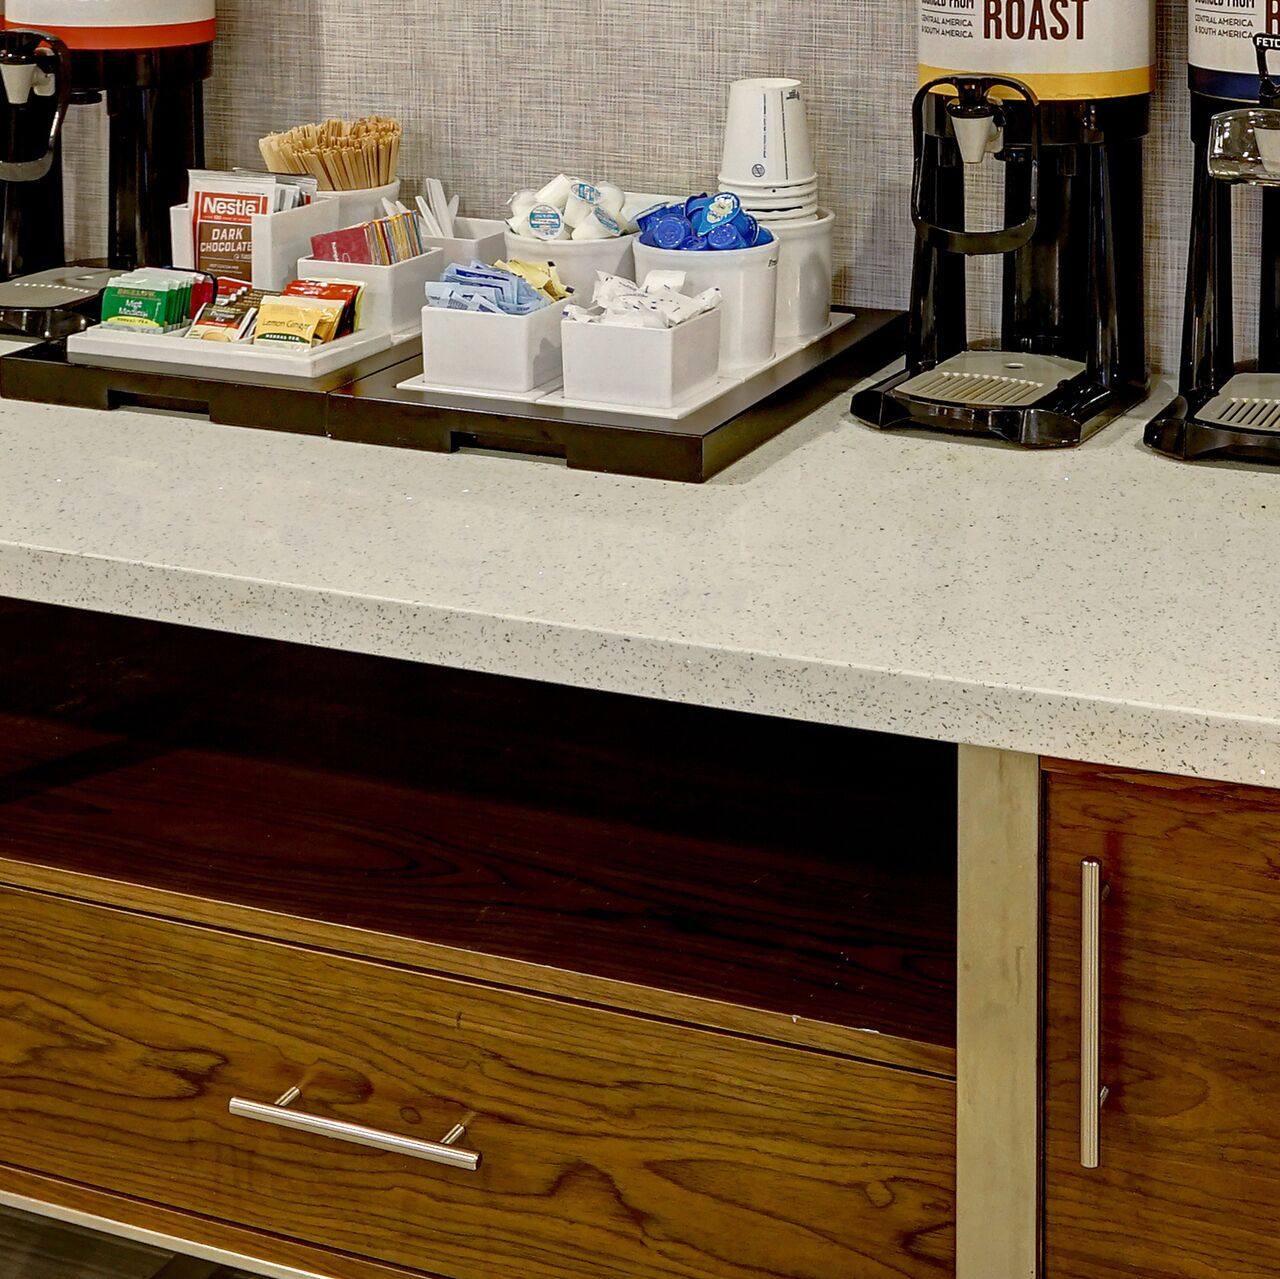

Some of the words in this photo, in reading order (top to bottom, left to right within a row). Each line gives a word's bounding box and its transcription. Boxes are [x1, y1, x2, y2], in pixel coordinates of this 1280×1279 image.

[942, 17, 974, 27] AMERICA
[1194, 14, 1218, 25] CENTRAL
[1218, 18, 1254, 28] AMERICA
[925, 26, 940, 36] SOUTH
[941, 28, 974, 38] AMERICA
[1198, 27, 1218, 36] SOUTH
[1218, 29, 1254, 39] AMERICA
[212, 228, 244, 241] DARK
[200, 241, 252, 253] CHOCOLATE
[262, 318, 286, 328] Lemon
